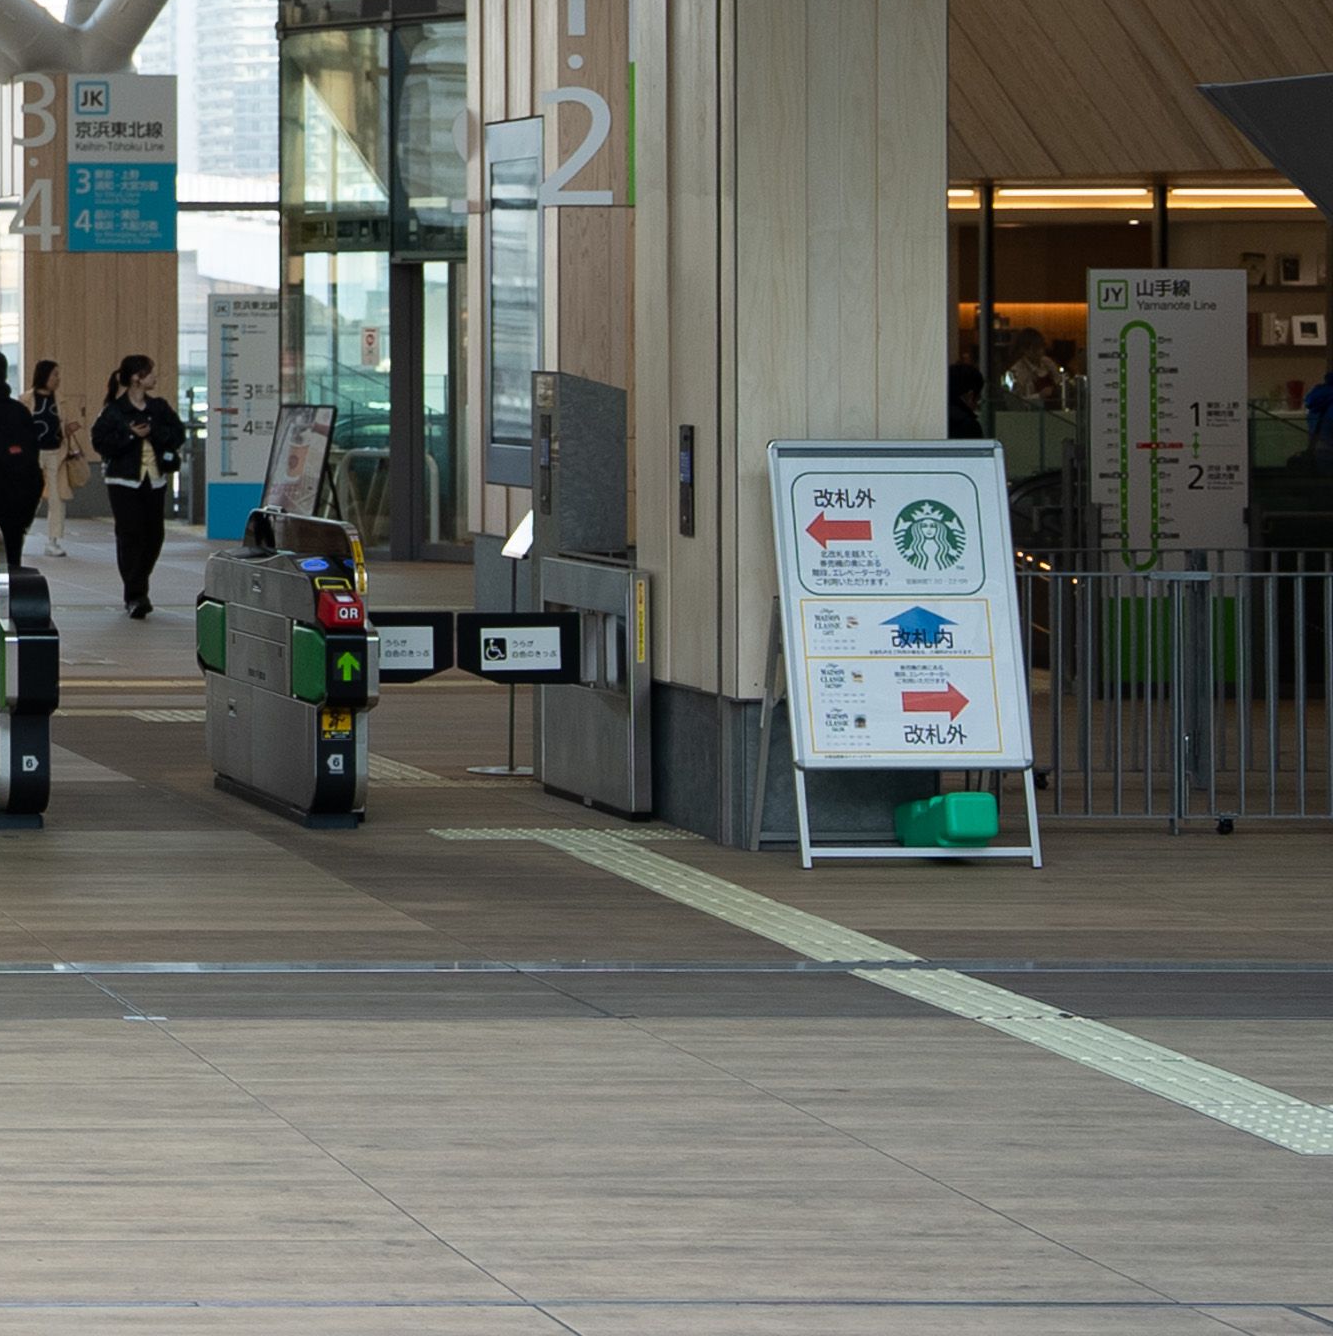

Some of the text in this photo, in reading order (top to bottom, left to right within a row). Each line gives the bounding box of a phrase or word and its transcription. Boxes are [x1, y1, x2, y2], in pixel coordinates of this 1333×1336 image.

[80, 90, 104, 107] JK
[12, 72, 57, 148] 3
[75, 121, 164, 139] 京浜東北線
[144, 141, 165, 152] Line
[539, 86, 614, 206] 2
[75, 169, 92, 194] 3
[9, 179, 62, 252] 4
[74, 209, 93, 234] 4
[1102, 288, 1123, 302] JY
[1136, 279, 1191, 297] 山手線
[1136, 300, 1217, 311] Yamanote Line
[243, 384, 254, 400] 3
[1190, 402, 1200, 427] 1
[243, 420, 254, 435] 4
[1188, 465, 1204, 490] 2
[813, 487, 876, 509] 改札外
[338, 607, 359, 619] QR
[891, 628, 954, 649] 改札内
[904, 724, 968, 745] 改札外
[25, 759, 33, 768] 6
[332, 757, 340, 767] 6
